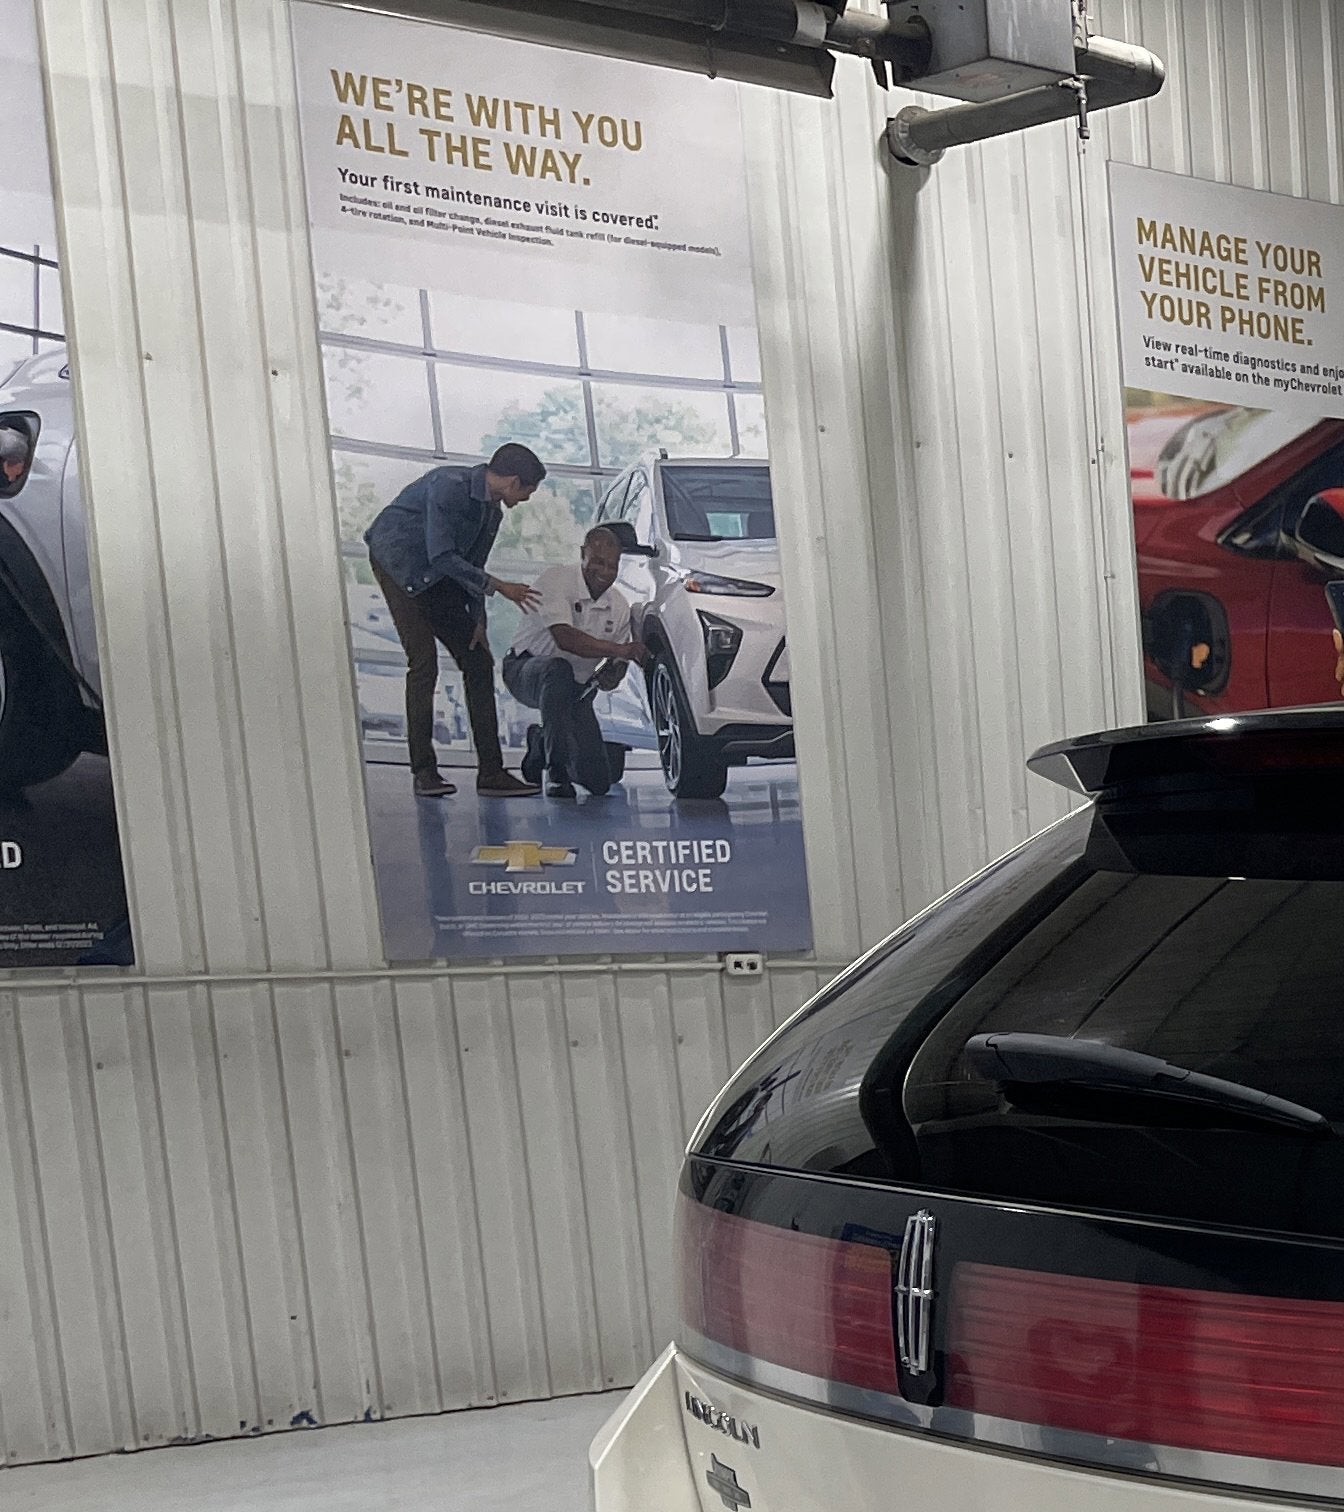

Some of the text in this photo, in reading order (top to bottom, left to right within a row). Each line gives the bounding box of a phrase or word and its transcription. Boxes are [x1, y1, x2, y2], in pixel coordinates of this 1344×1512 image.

[330, 69, 643, 151] WE'RE WITH YOU
[336, 114, 591, 186] ALL THE WAY.
[338, 167, 378, 188] Your
[383, 175, 421, 196] first
[425, 185, 531, 213] maintenance
[535, 200, 570, 219] visit
[574, 204, 588, 221] is
[1137, 217, 1322, 278] MANAGE YOUR
[1138, 253, 1326, 314] VEHICLE FROM
[1140, 290, 1313, 346] YOUR PHONE.
[1143, 335, 1172, 352] View
[1175, 344, 1230, 362] real-time
[1232, 351, 1297, 373] diagnostics
[1300, 363, 1320, 376] and
[1181, 362, 1232, 380] available
[1235, 372, 1249, 383] on
[1252, 372, 1271, 387] the
[1273, 377, 1342, 396] myChevrolet
[0, 841, 22, 868] D
[602, 839, 731, 866] CERTIFIED
[469, 880, 586, 895] CHEVROLET
[606, 868, 714, 894] SERVICE
